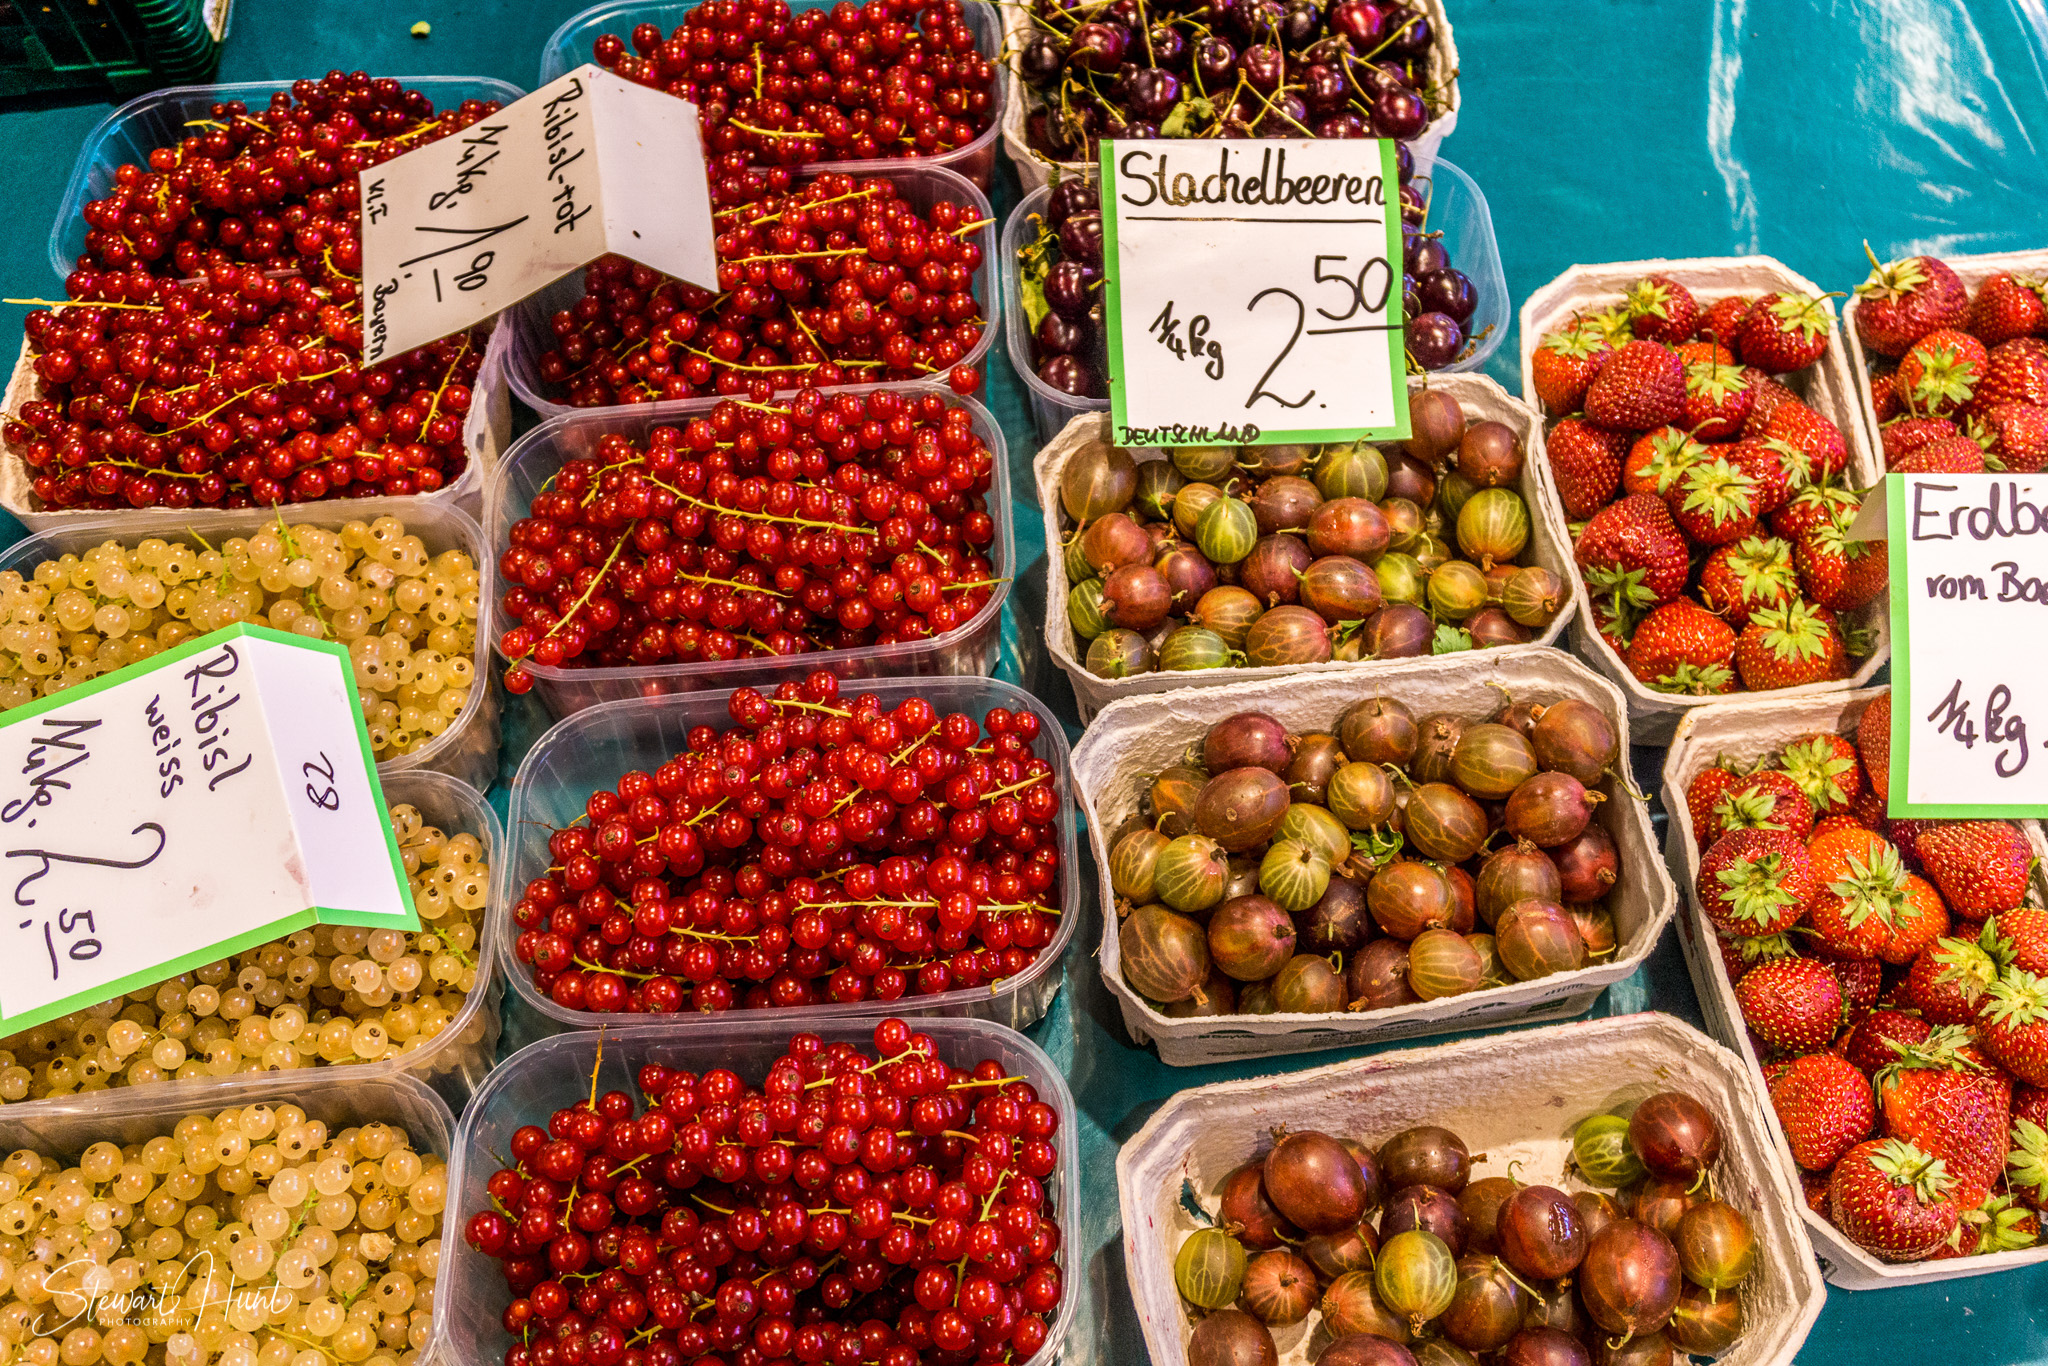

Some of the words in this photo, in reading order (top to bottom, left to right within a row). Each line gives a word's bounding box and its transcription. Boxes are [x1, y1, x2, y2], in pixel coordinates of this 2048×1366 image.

[1120, 147, 1387, 207] Stachelbeeren
[370, 278, 398, 361] Bayern
[1118, 421, 1261, 446] DEUTSCHLAND
[144, 694, 184, 799] weiss
[184, 643, 253, 792] Ribisl
